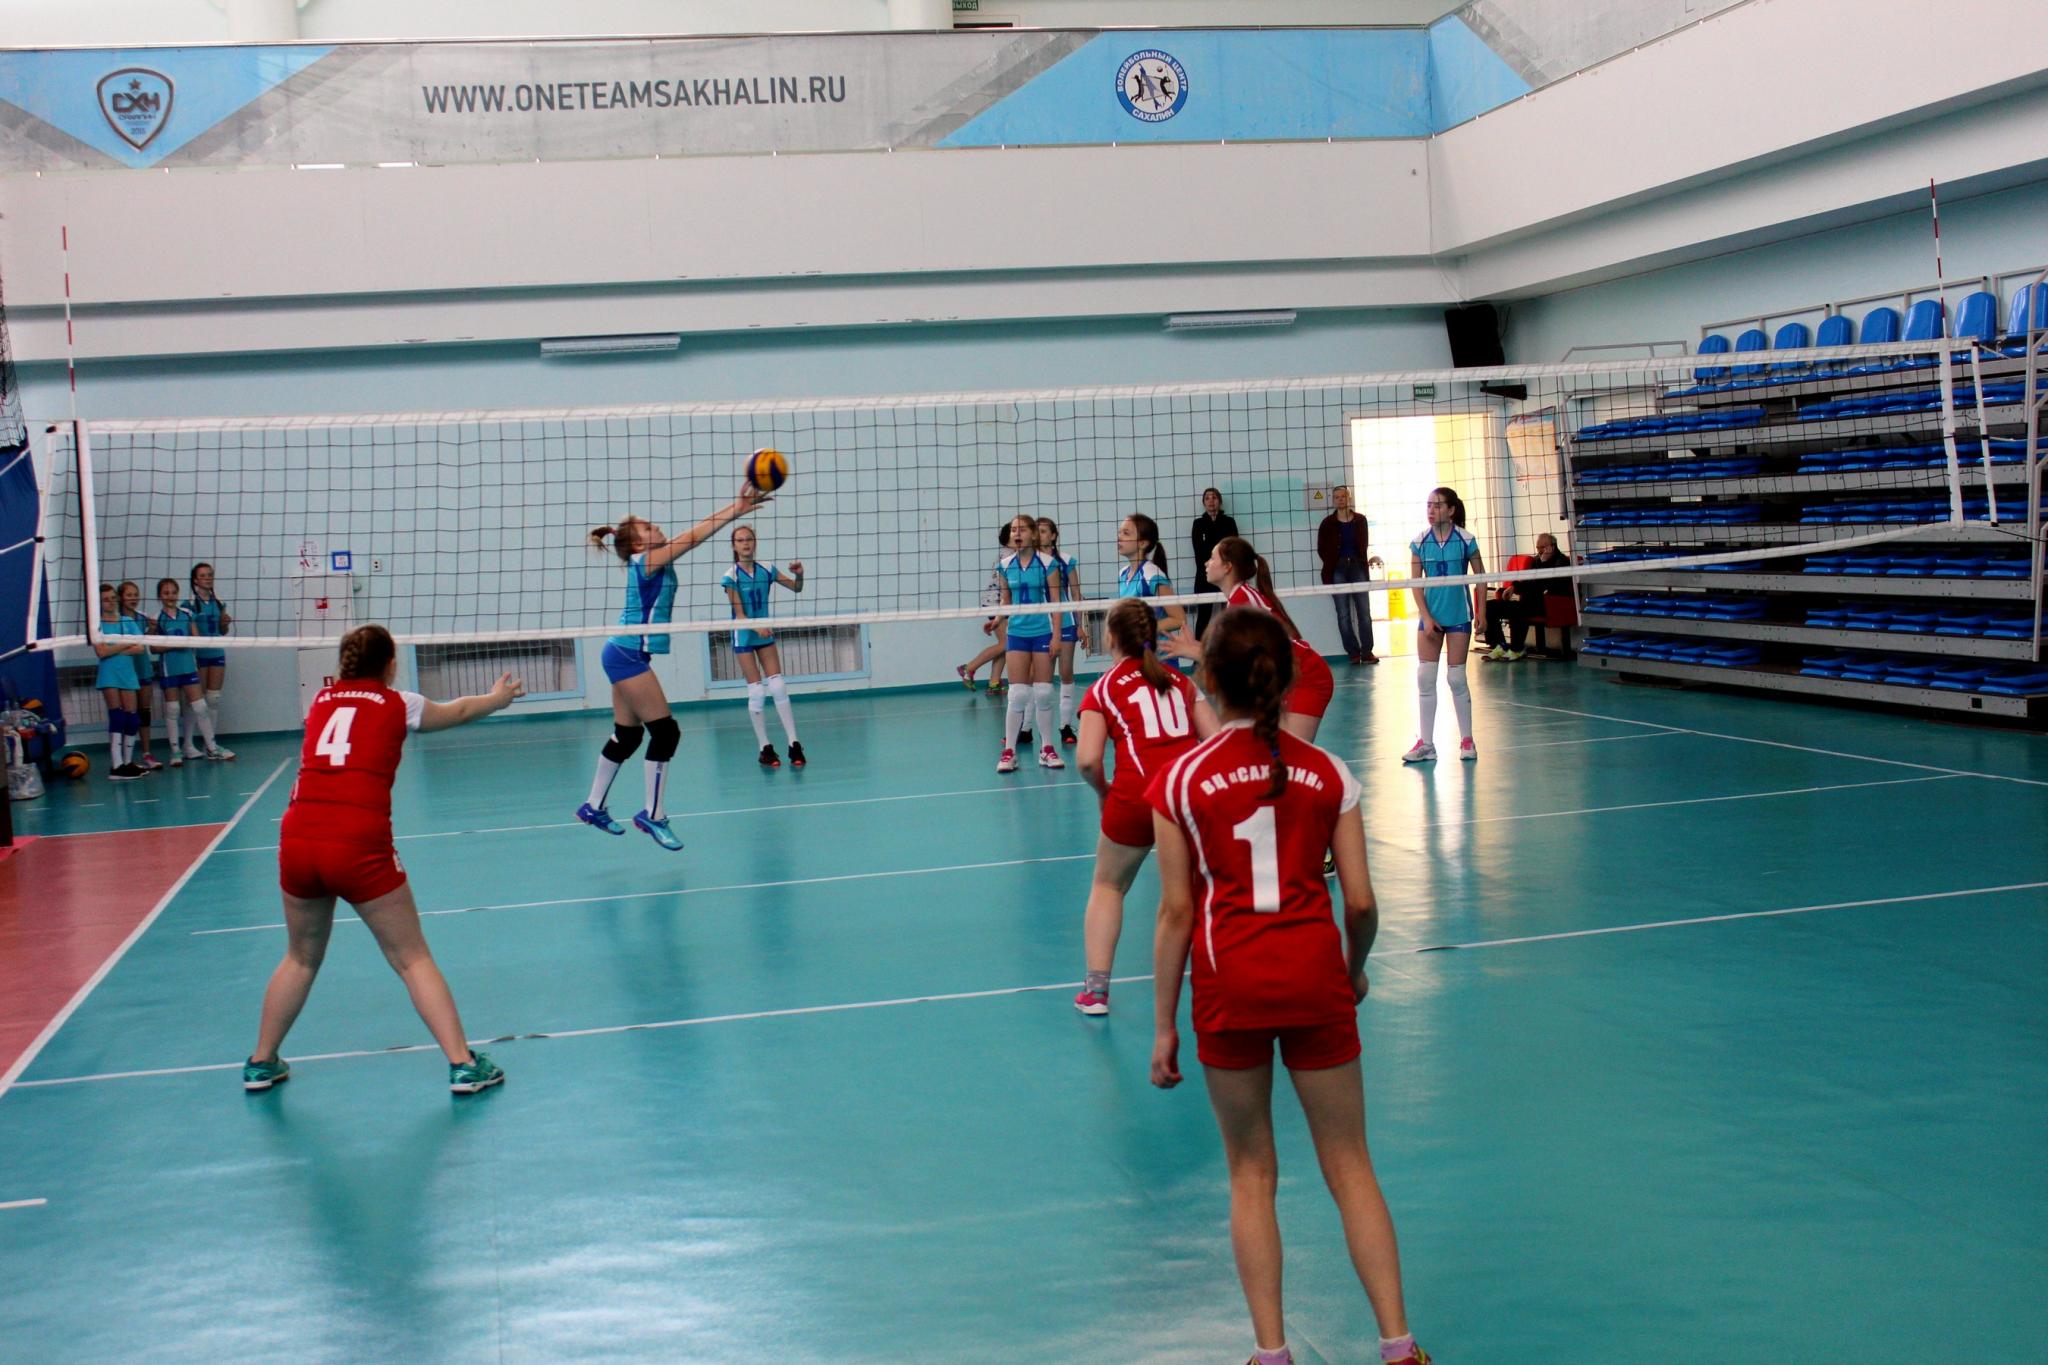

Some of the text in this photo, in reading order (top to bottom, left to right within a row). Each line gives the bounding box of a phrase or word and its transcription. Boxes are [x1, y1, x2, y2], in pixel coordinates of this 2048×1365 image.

[1171, 61, 1188, 92] ЦЕНТР
[422, 75, 846, 113] WWW.ONETEAMSAKHALIN.RU
[1132, 108, 1175, 122] САХАЛИН
[749, 588, 763, 612] 11
[1127, 685, 1190, 739] 10
[315, 706, 358, 766] 4
[1200, 772, 1229, 796] ВЦ
[1233, 806, 1281, 912] 1
